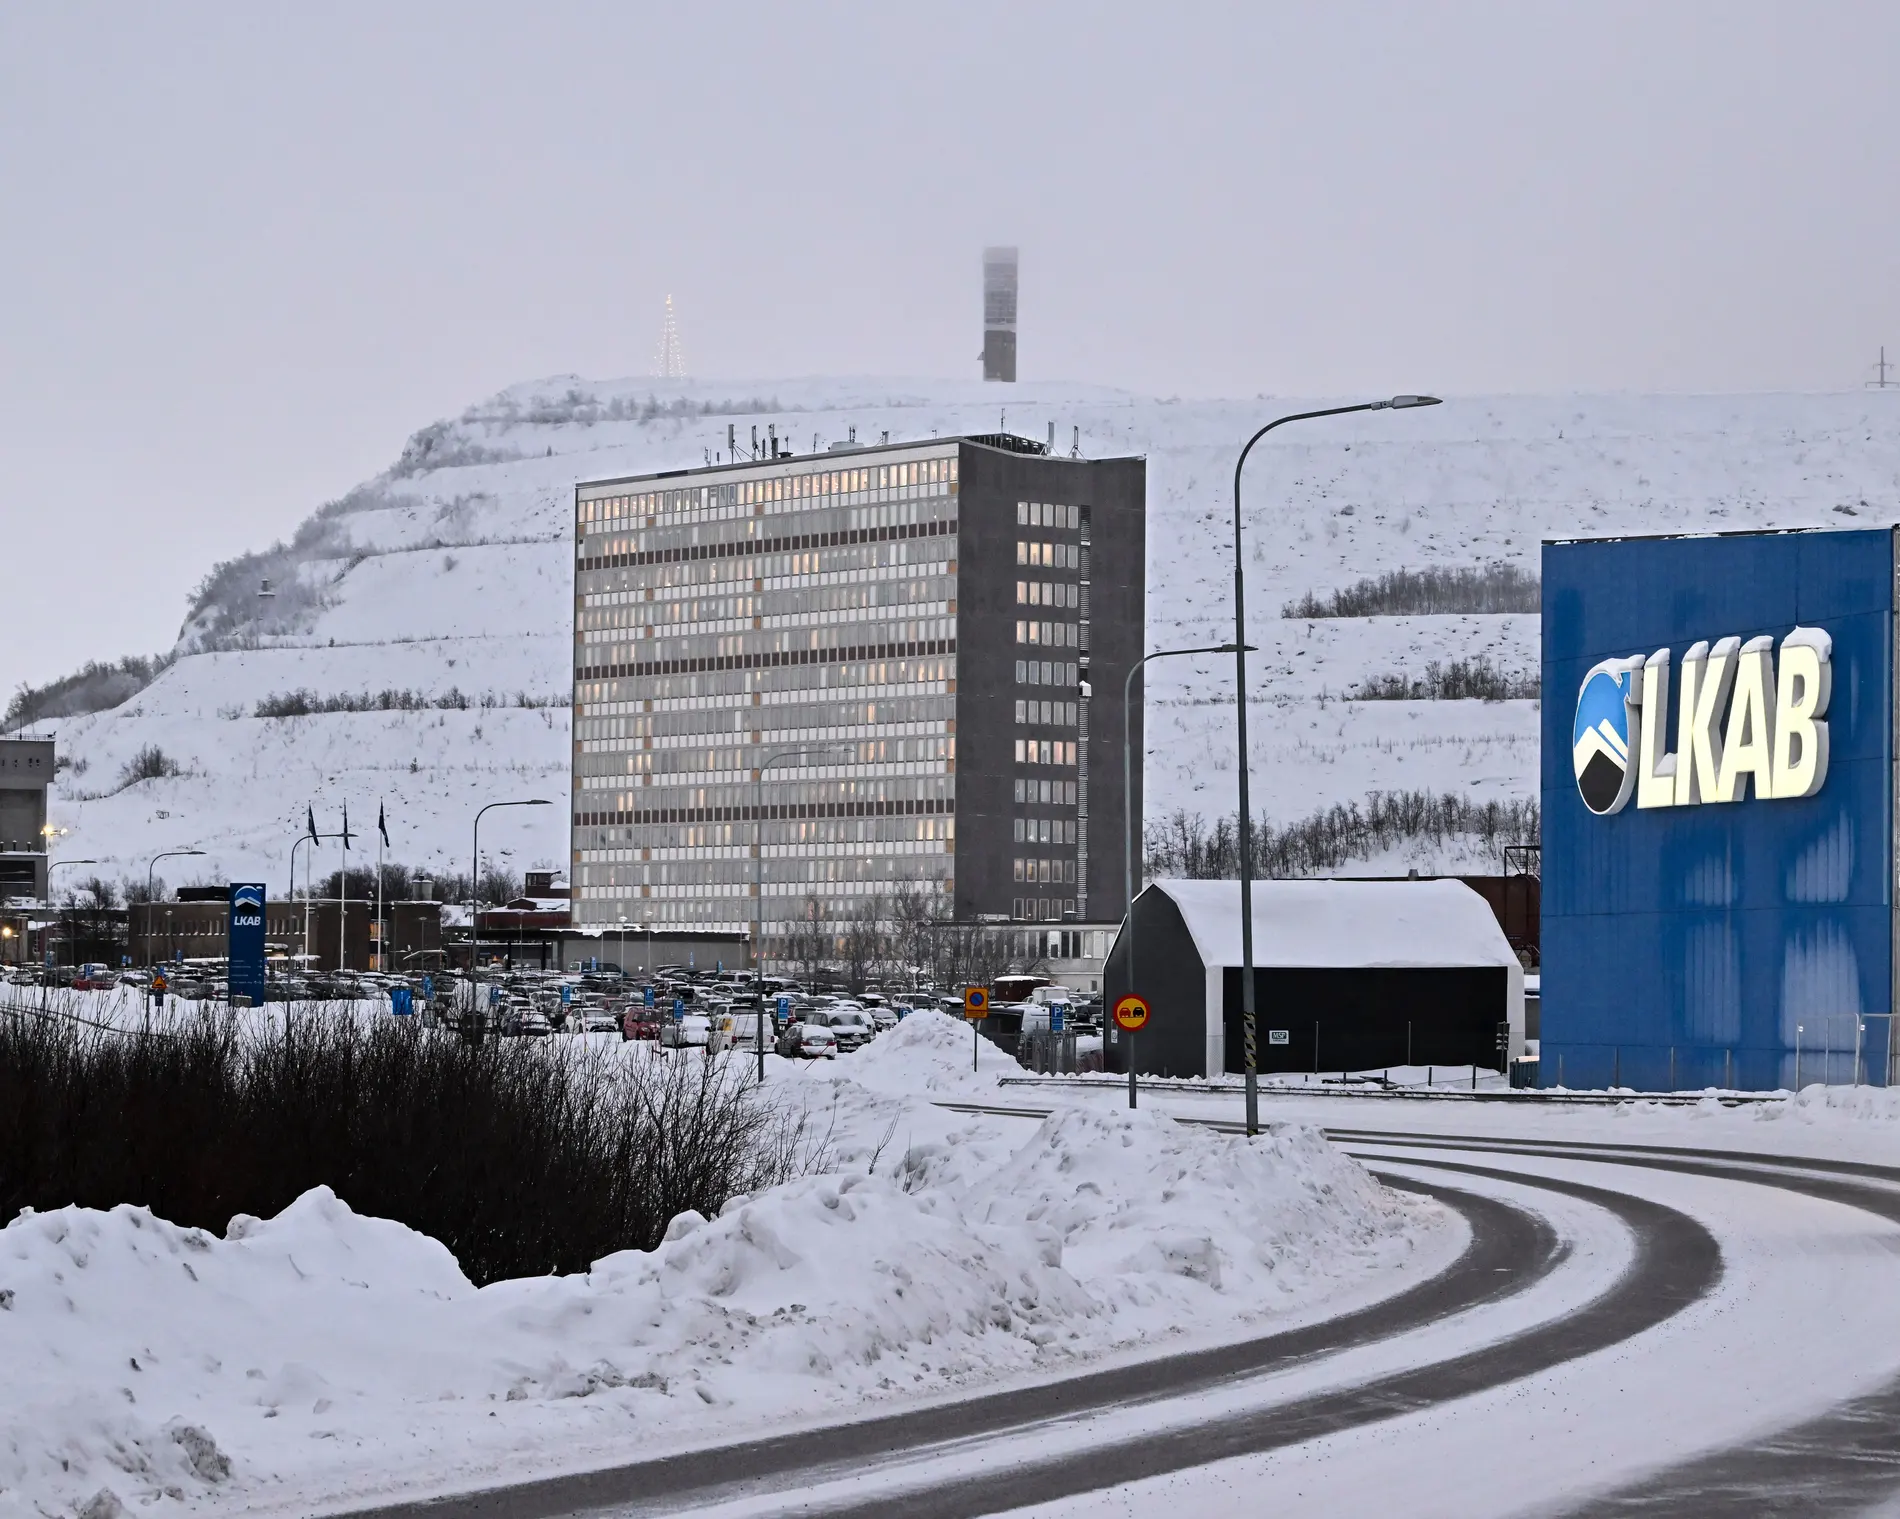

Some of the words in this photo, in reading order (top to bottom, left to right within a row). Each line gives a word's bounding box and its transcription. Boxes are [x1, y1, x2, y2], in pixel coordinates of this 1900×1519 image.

[1637, 632, 1831, 809] LKAB
[234, 916, 261, 926] LKAB
[647, 988, 652, 996] P
[677, 1000, 682, 1008] P
[780, 999, 786, 1007] P
[1055, 1007, 1061, 1017] P
